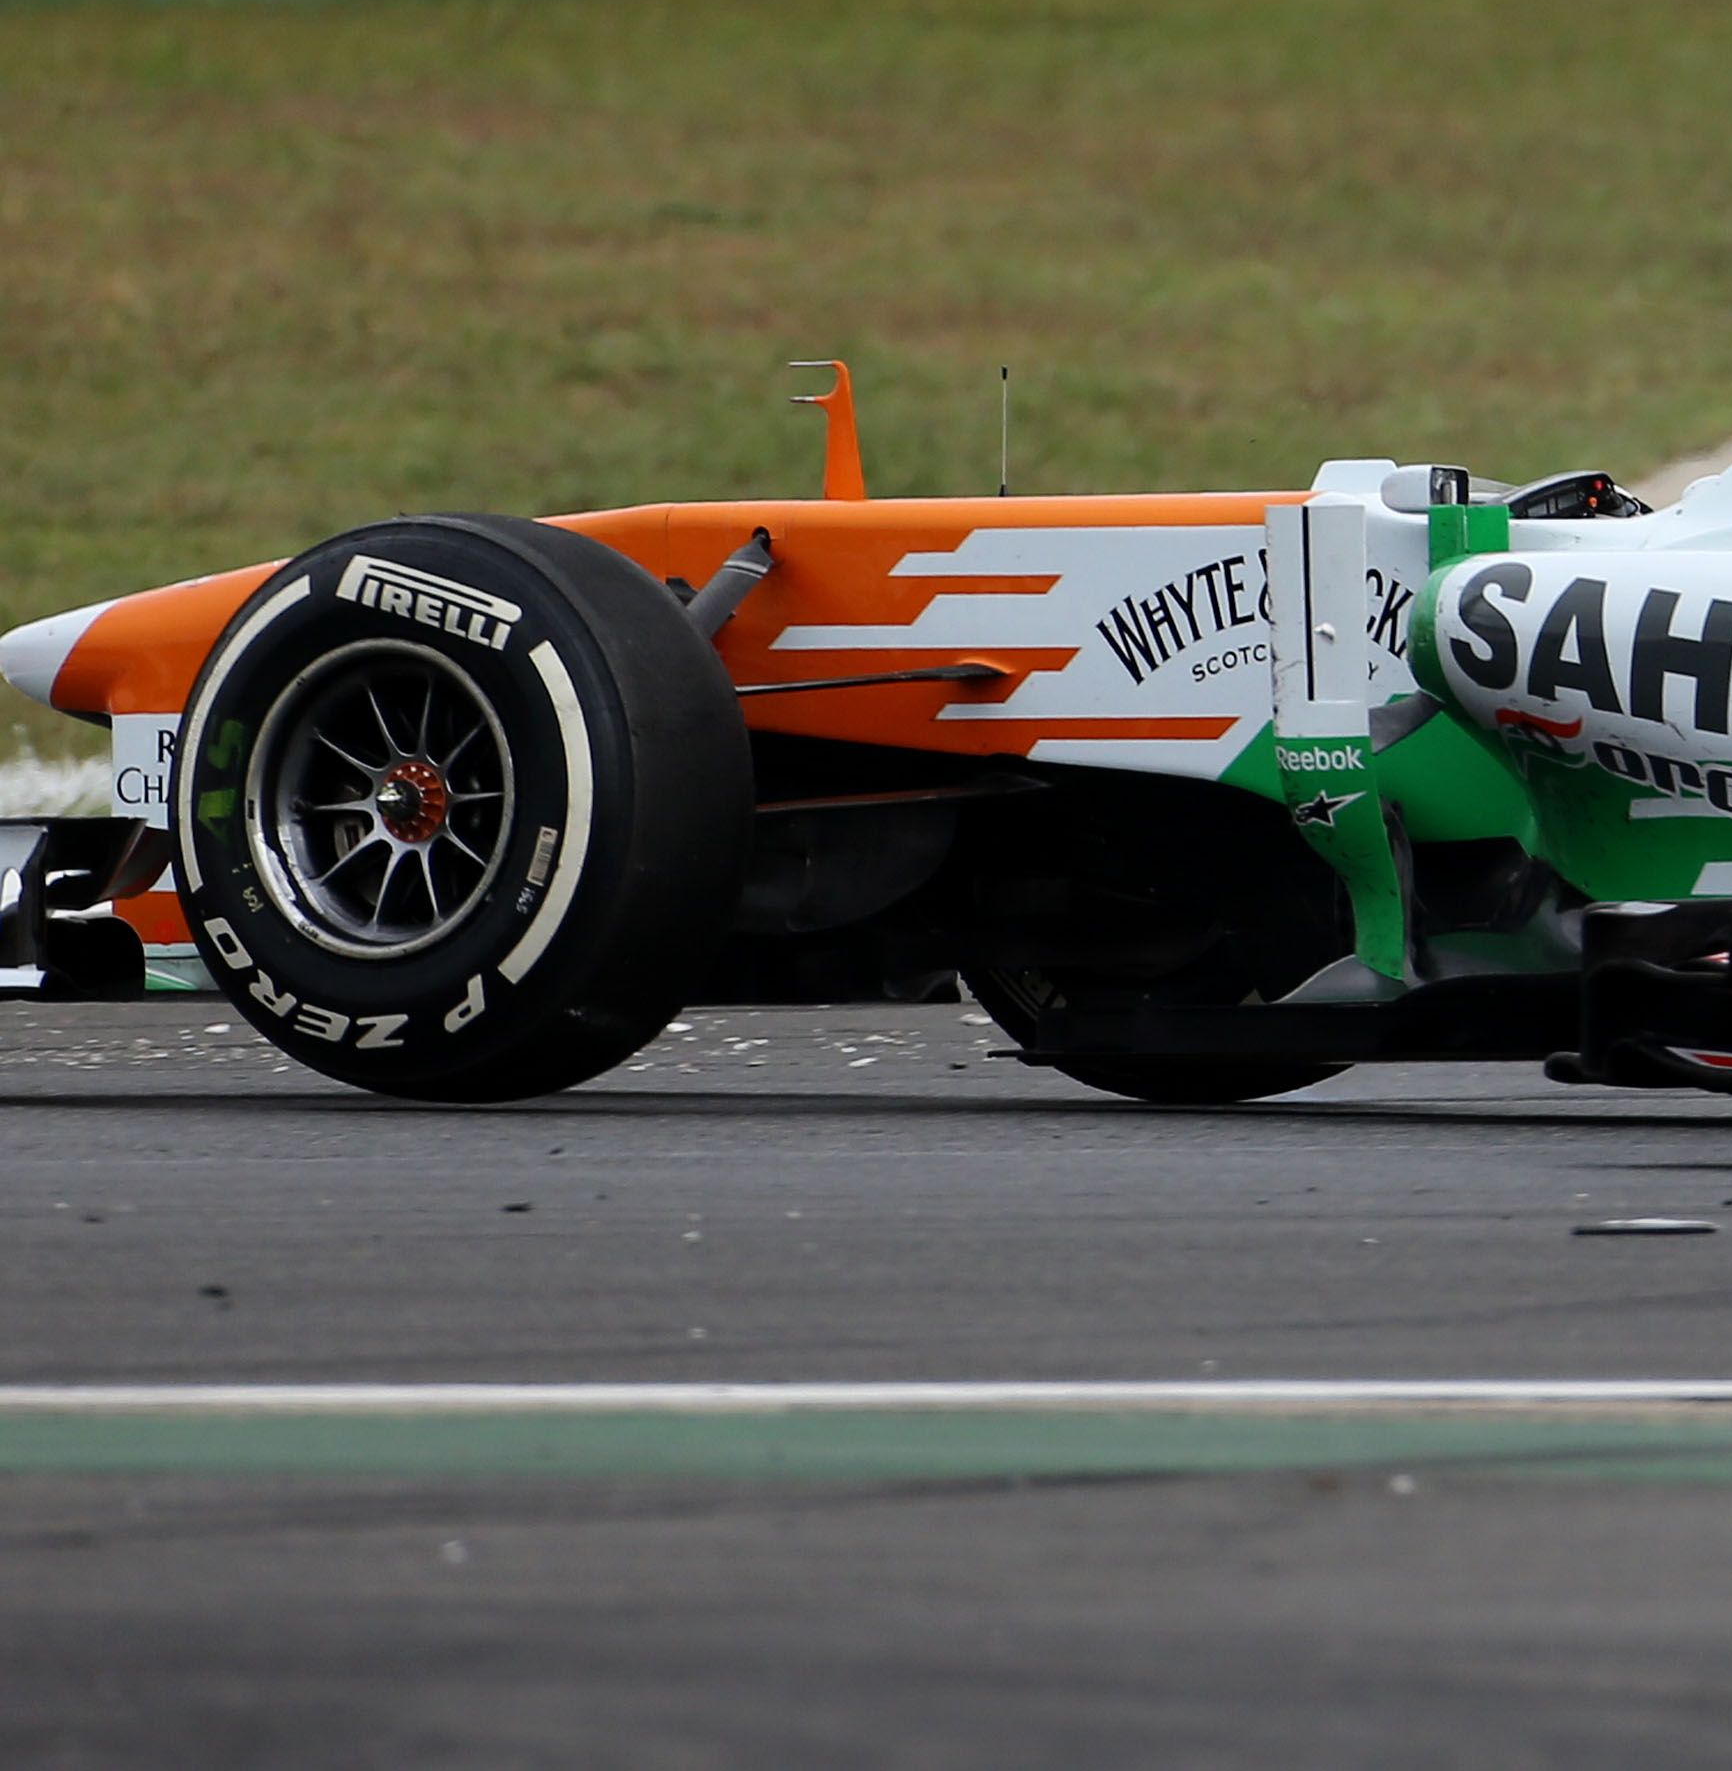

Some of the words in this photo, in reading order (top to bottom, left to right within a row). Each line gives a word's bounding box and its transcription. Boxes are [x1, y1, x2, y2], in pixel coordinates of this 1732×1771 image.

[334, 554, 524, 652] PIRELLI
[1096, 554, 1256, 686] WHYTE
[1192, 644, 1267, 683] SCOTC
[1275, 745, 1364, 771] Reebok
[203, 916, 409, 1050] ZERO
[444, 973, 486, 1032] P
